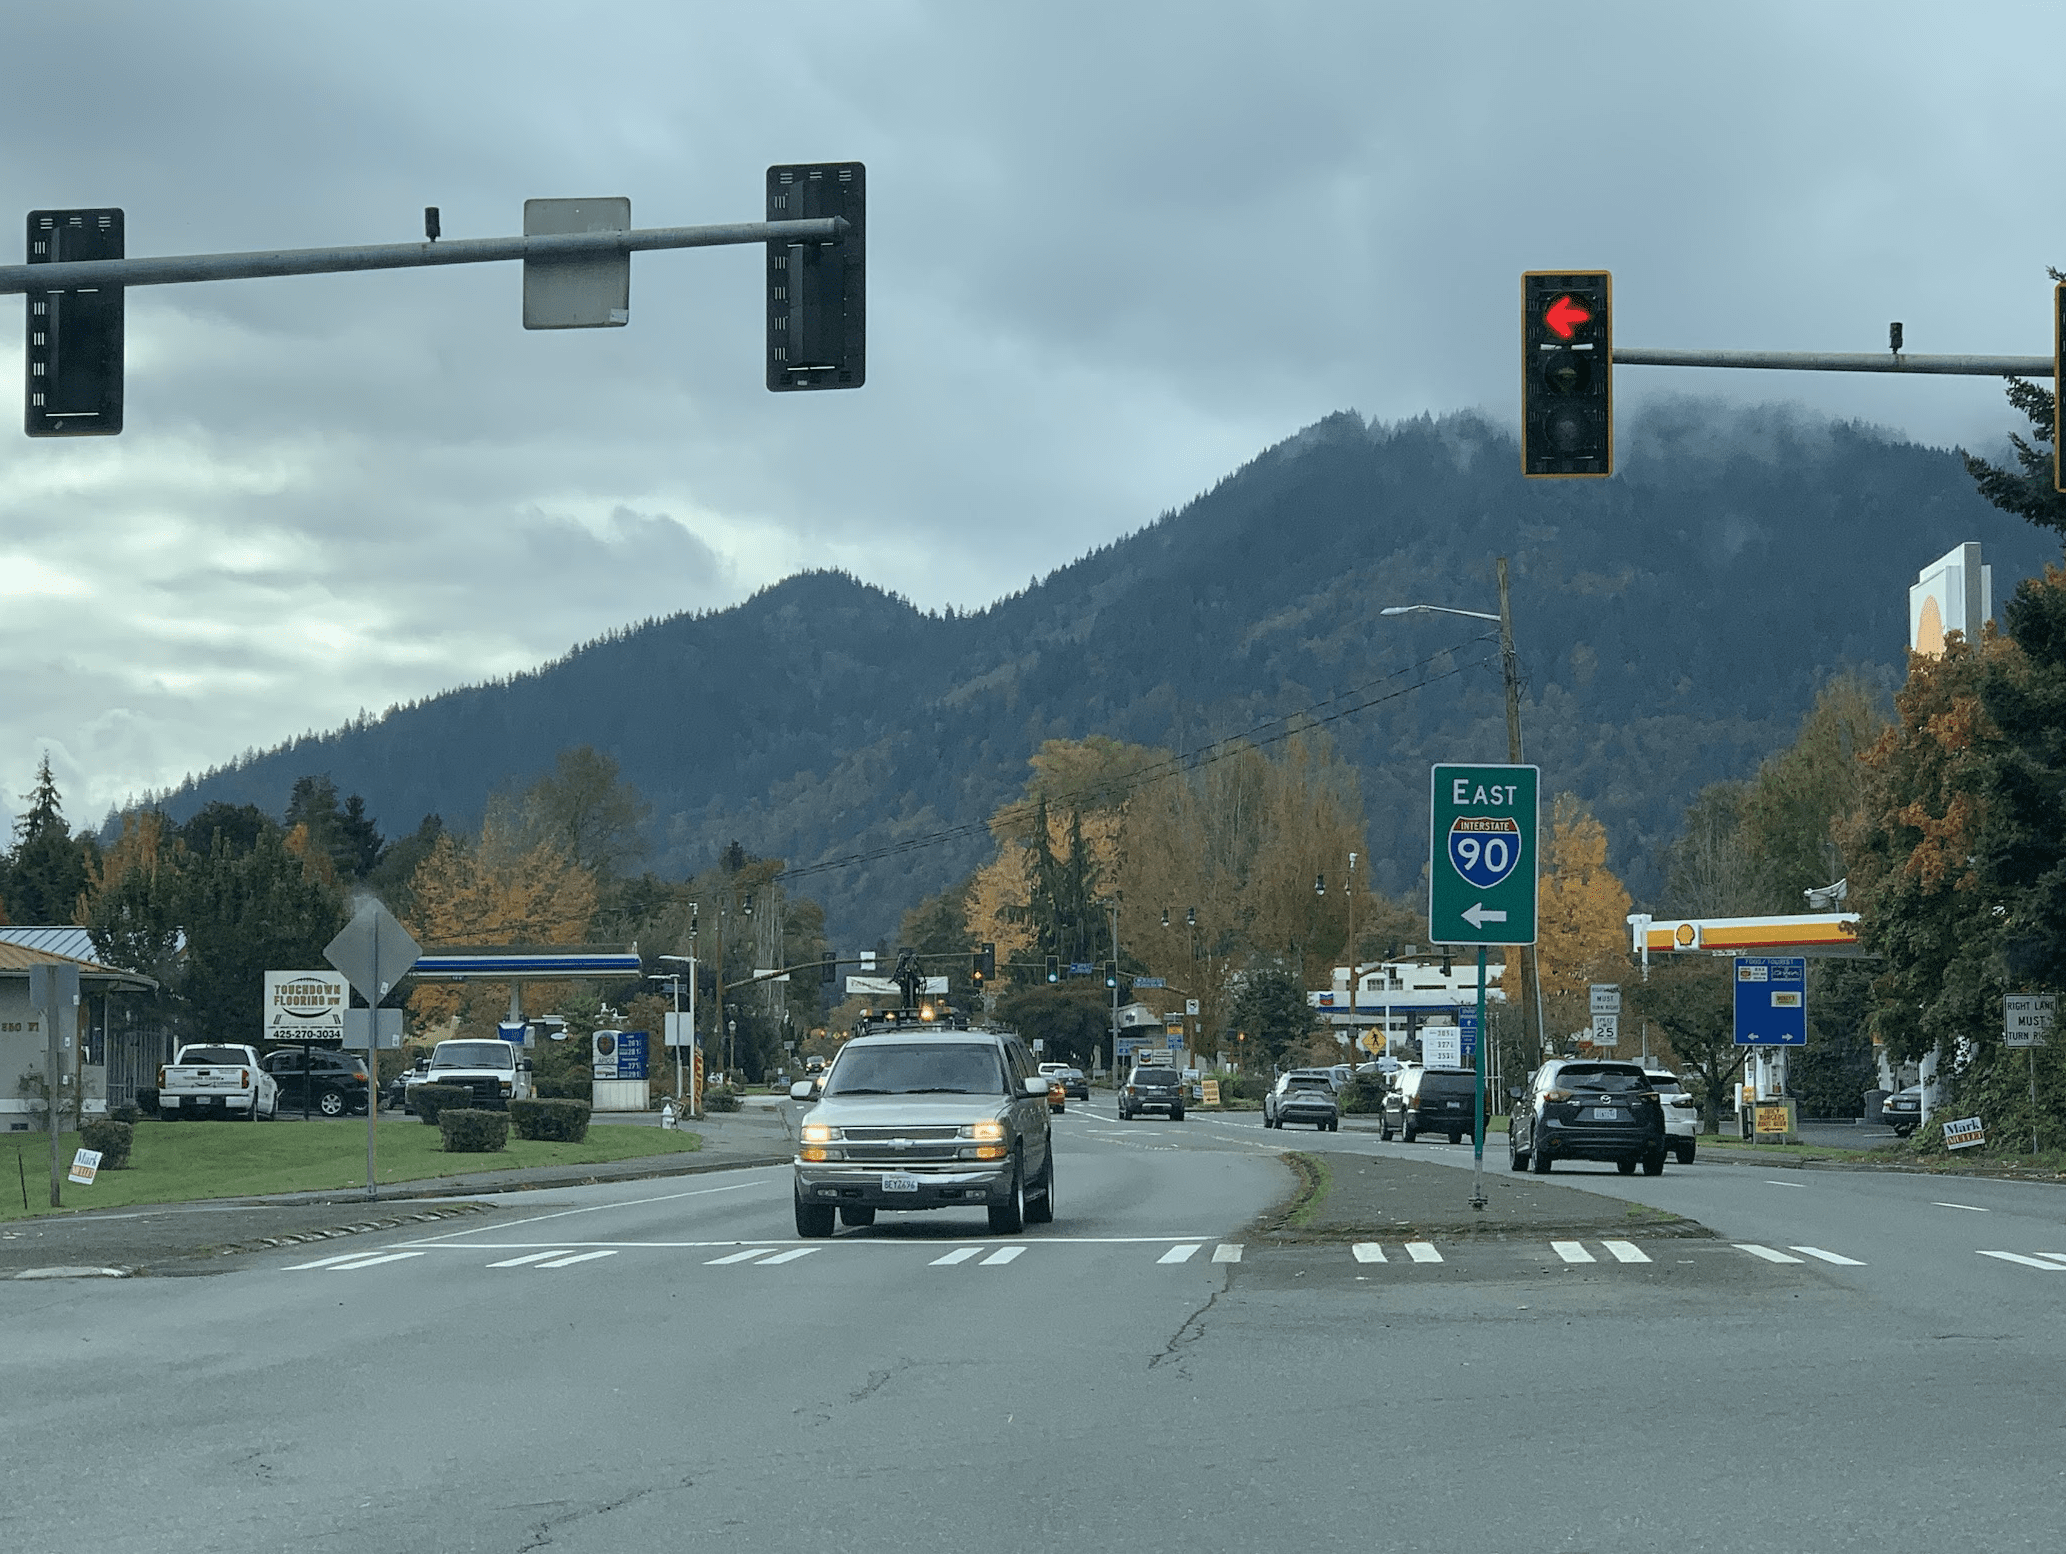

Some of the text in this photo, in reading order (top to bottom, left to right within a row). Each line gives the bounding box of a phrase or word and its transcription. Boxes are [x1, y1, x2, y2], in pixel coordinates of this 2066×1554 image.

[1460, 821, 1511, 831] INTERSTATE
[1457, 837, 1509, 873] 90
[274, 984, 341, 995] TOUCHDOWN
[274, 995, 325, 1006] FLOORING
[2007, 1001, 2030, 1011] RIGHT
[2018, 1016, 2045, 1027] MUST
[273, 1030, 341, 1039] 425-270-3034
[1596, 1027, 1614, 1038] 25
[2008, 1031, 2029, 1041] TURN
[1946, 1119, 1980, 1135] Mark
